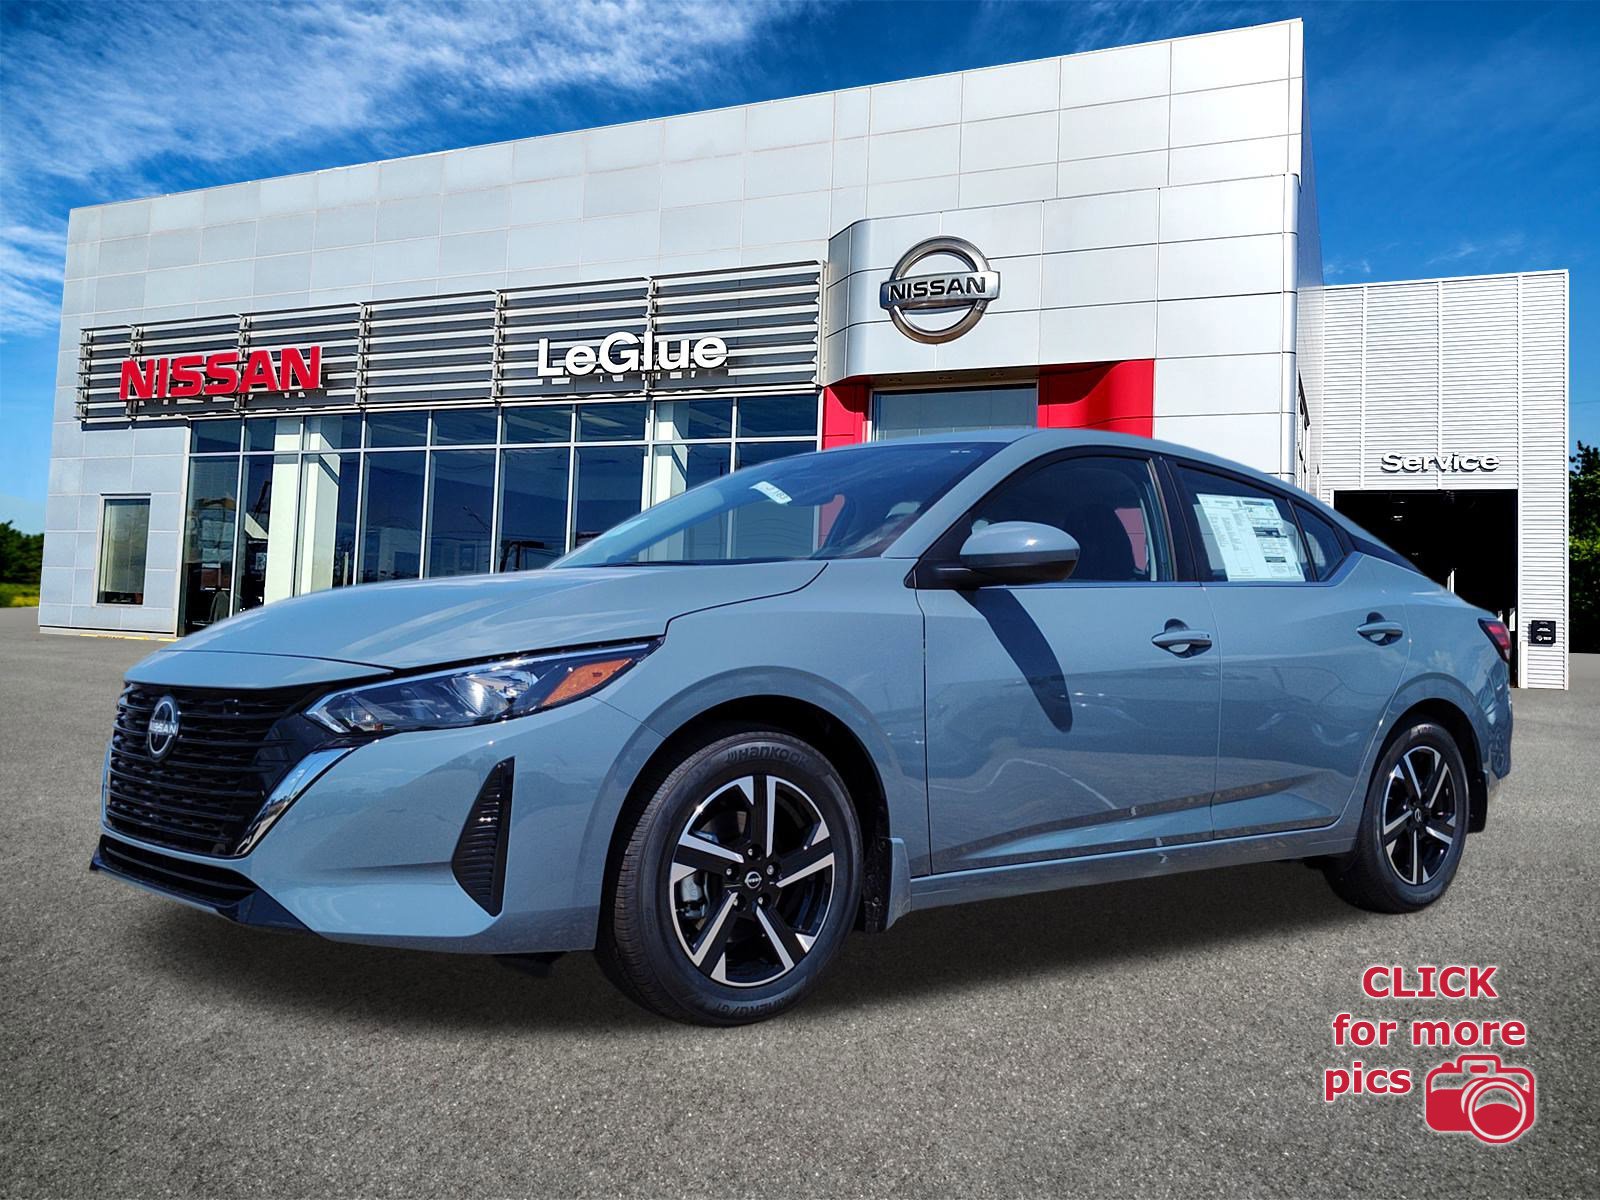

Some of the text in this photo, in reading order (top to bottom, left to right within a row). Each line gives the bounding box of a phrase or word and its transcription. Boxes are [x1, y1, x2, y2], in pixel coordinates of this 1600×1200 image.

[888, 276, 986, 301] NISSAN
[537, 331, 728, 377] LeGlue
[119, 345, 322, 400] NISSAN
[1380, 451, 1500, 472] Service
